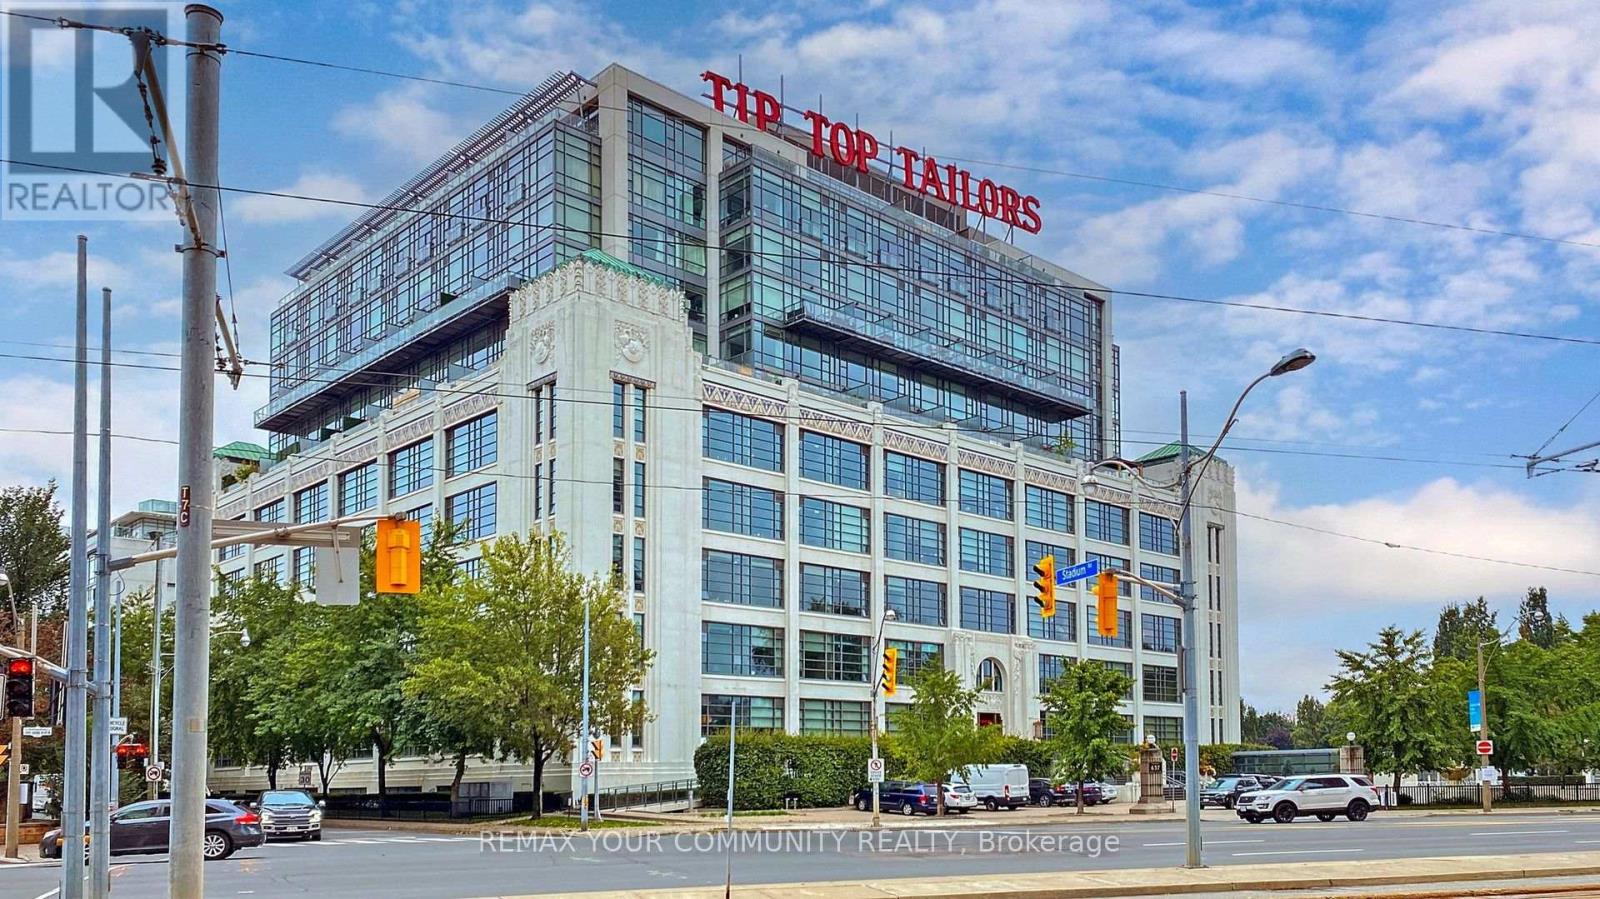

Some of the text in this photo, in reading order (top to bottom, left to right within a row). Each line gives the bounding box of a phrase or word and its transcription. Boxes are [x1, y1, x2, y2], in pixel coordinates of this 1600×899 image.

[701, 70, 1042, 235] TIP TOP TAILORS
[1062, 566, 1087, 581] Stadium
